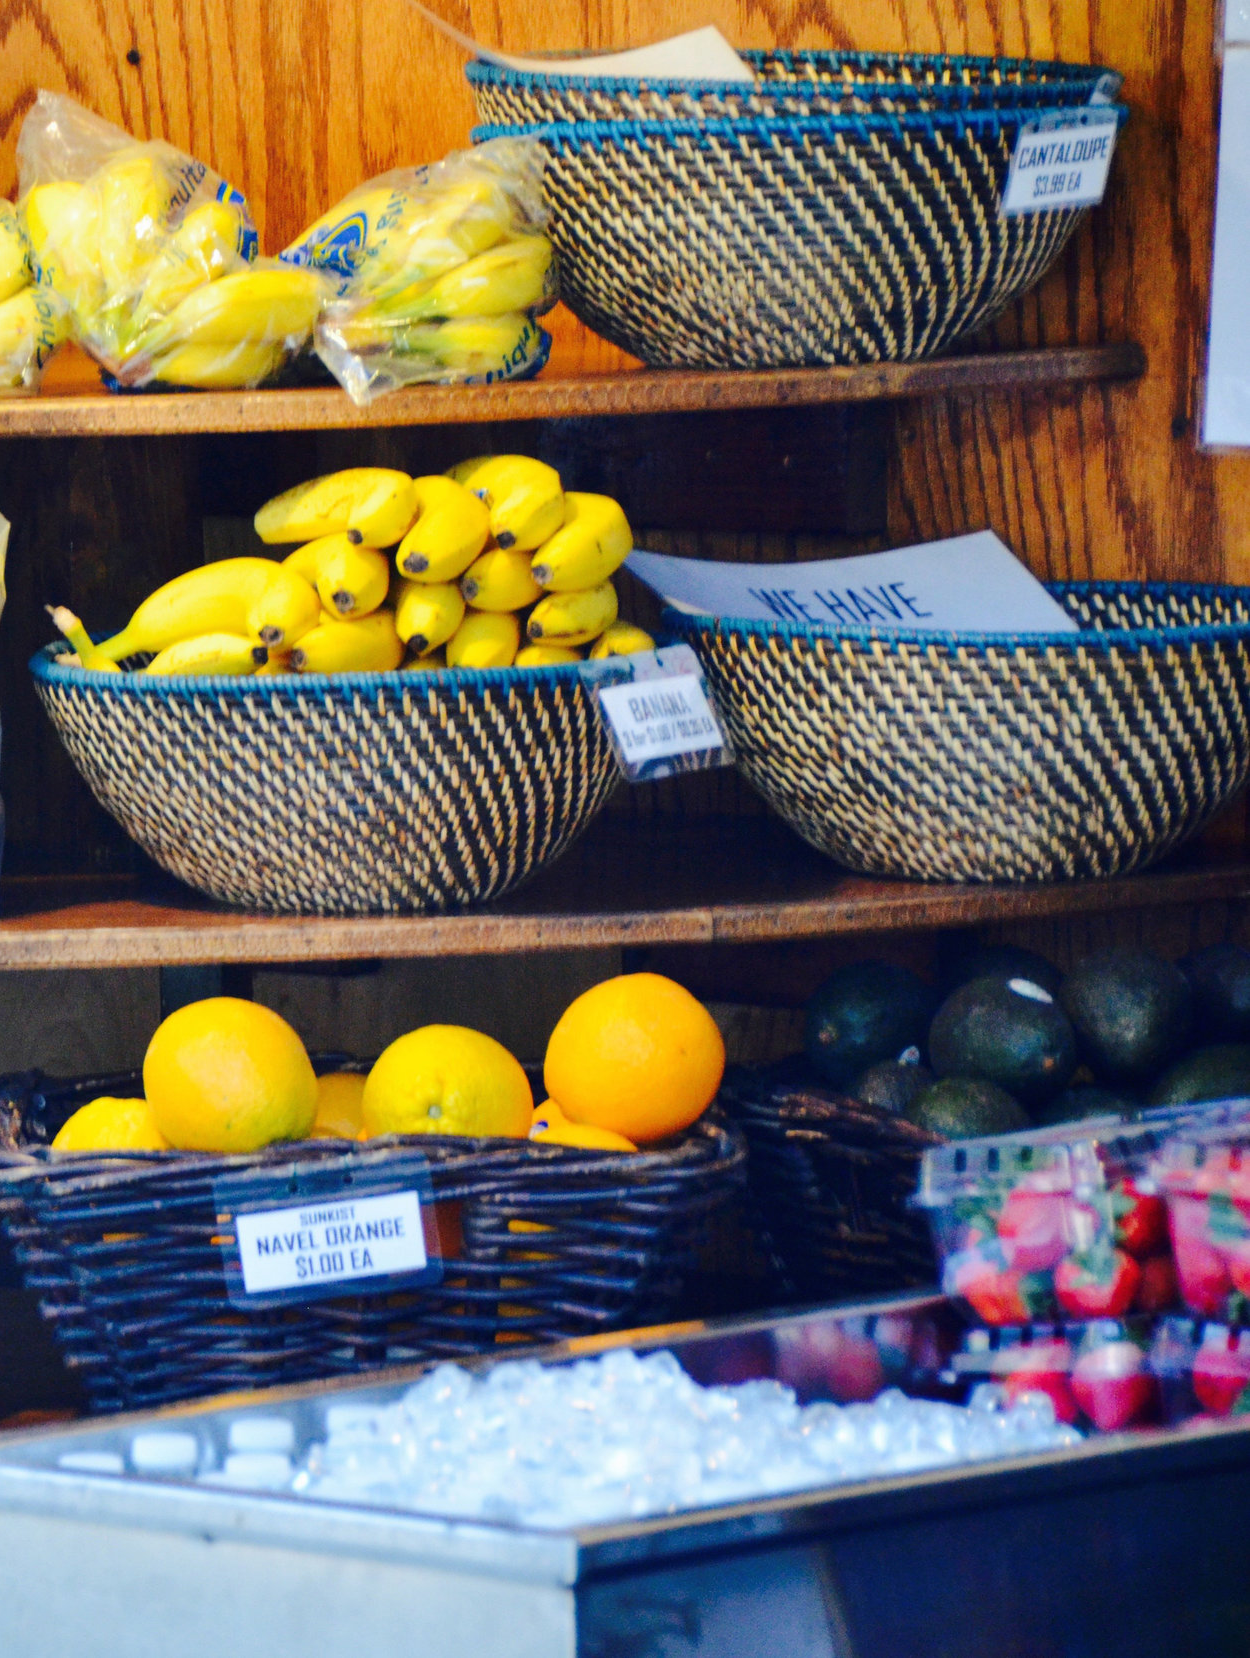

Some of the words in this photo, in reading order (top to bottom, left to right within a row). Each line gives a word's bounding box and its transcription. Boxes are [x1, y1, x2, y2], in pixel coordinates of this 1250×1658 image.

[1017, 136, 1111, 170] CANTALOUPE
[1033, 172, 1066, 198] $3.99
[1067, 171, 1082, 192] EA
[748, 588, 824, 622] WE
[813, 582, 933, 623] HAVE
[628, 691, 692, 722] BANANA
[298, 1205, 355, 1226] SUNKIST
[256, 1228, 319, 1256] NAVEL
[324, 1216, 406, 1247] ORANGE
[295, 1250, 345, 1279] $1.00
[350, 1247, 374, 1270] EA
